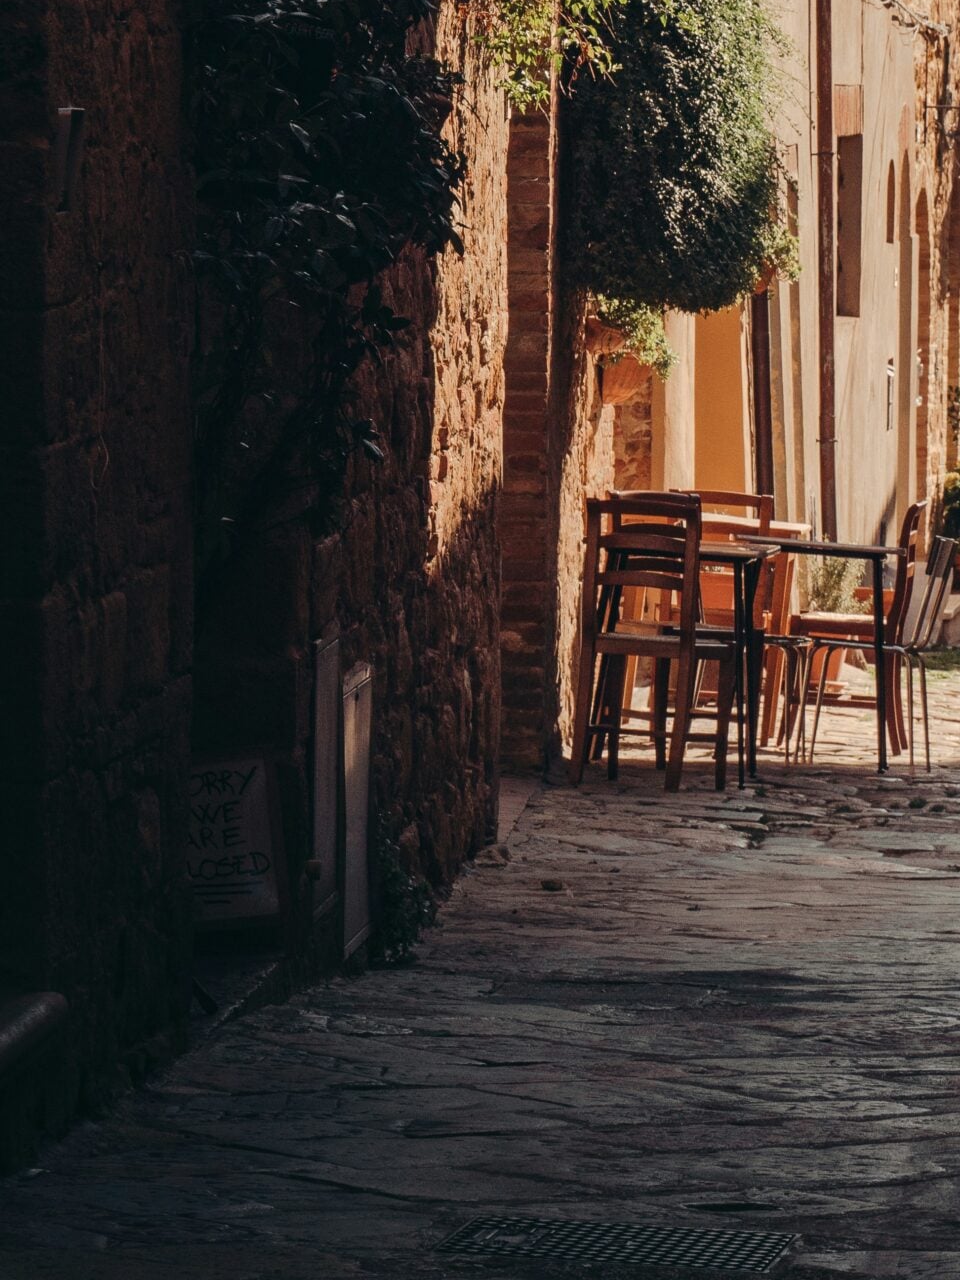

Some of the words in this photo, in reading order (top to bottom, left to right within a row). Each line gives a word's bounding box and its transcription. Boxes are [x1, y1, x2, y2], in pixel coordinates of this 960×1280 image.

[189, 766, 257, 797] ORRY
[191, 800, 243, 824] WE
[186, 852, 271, 880] LOSED
